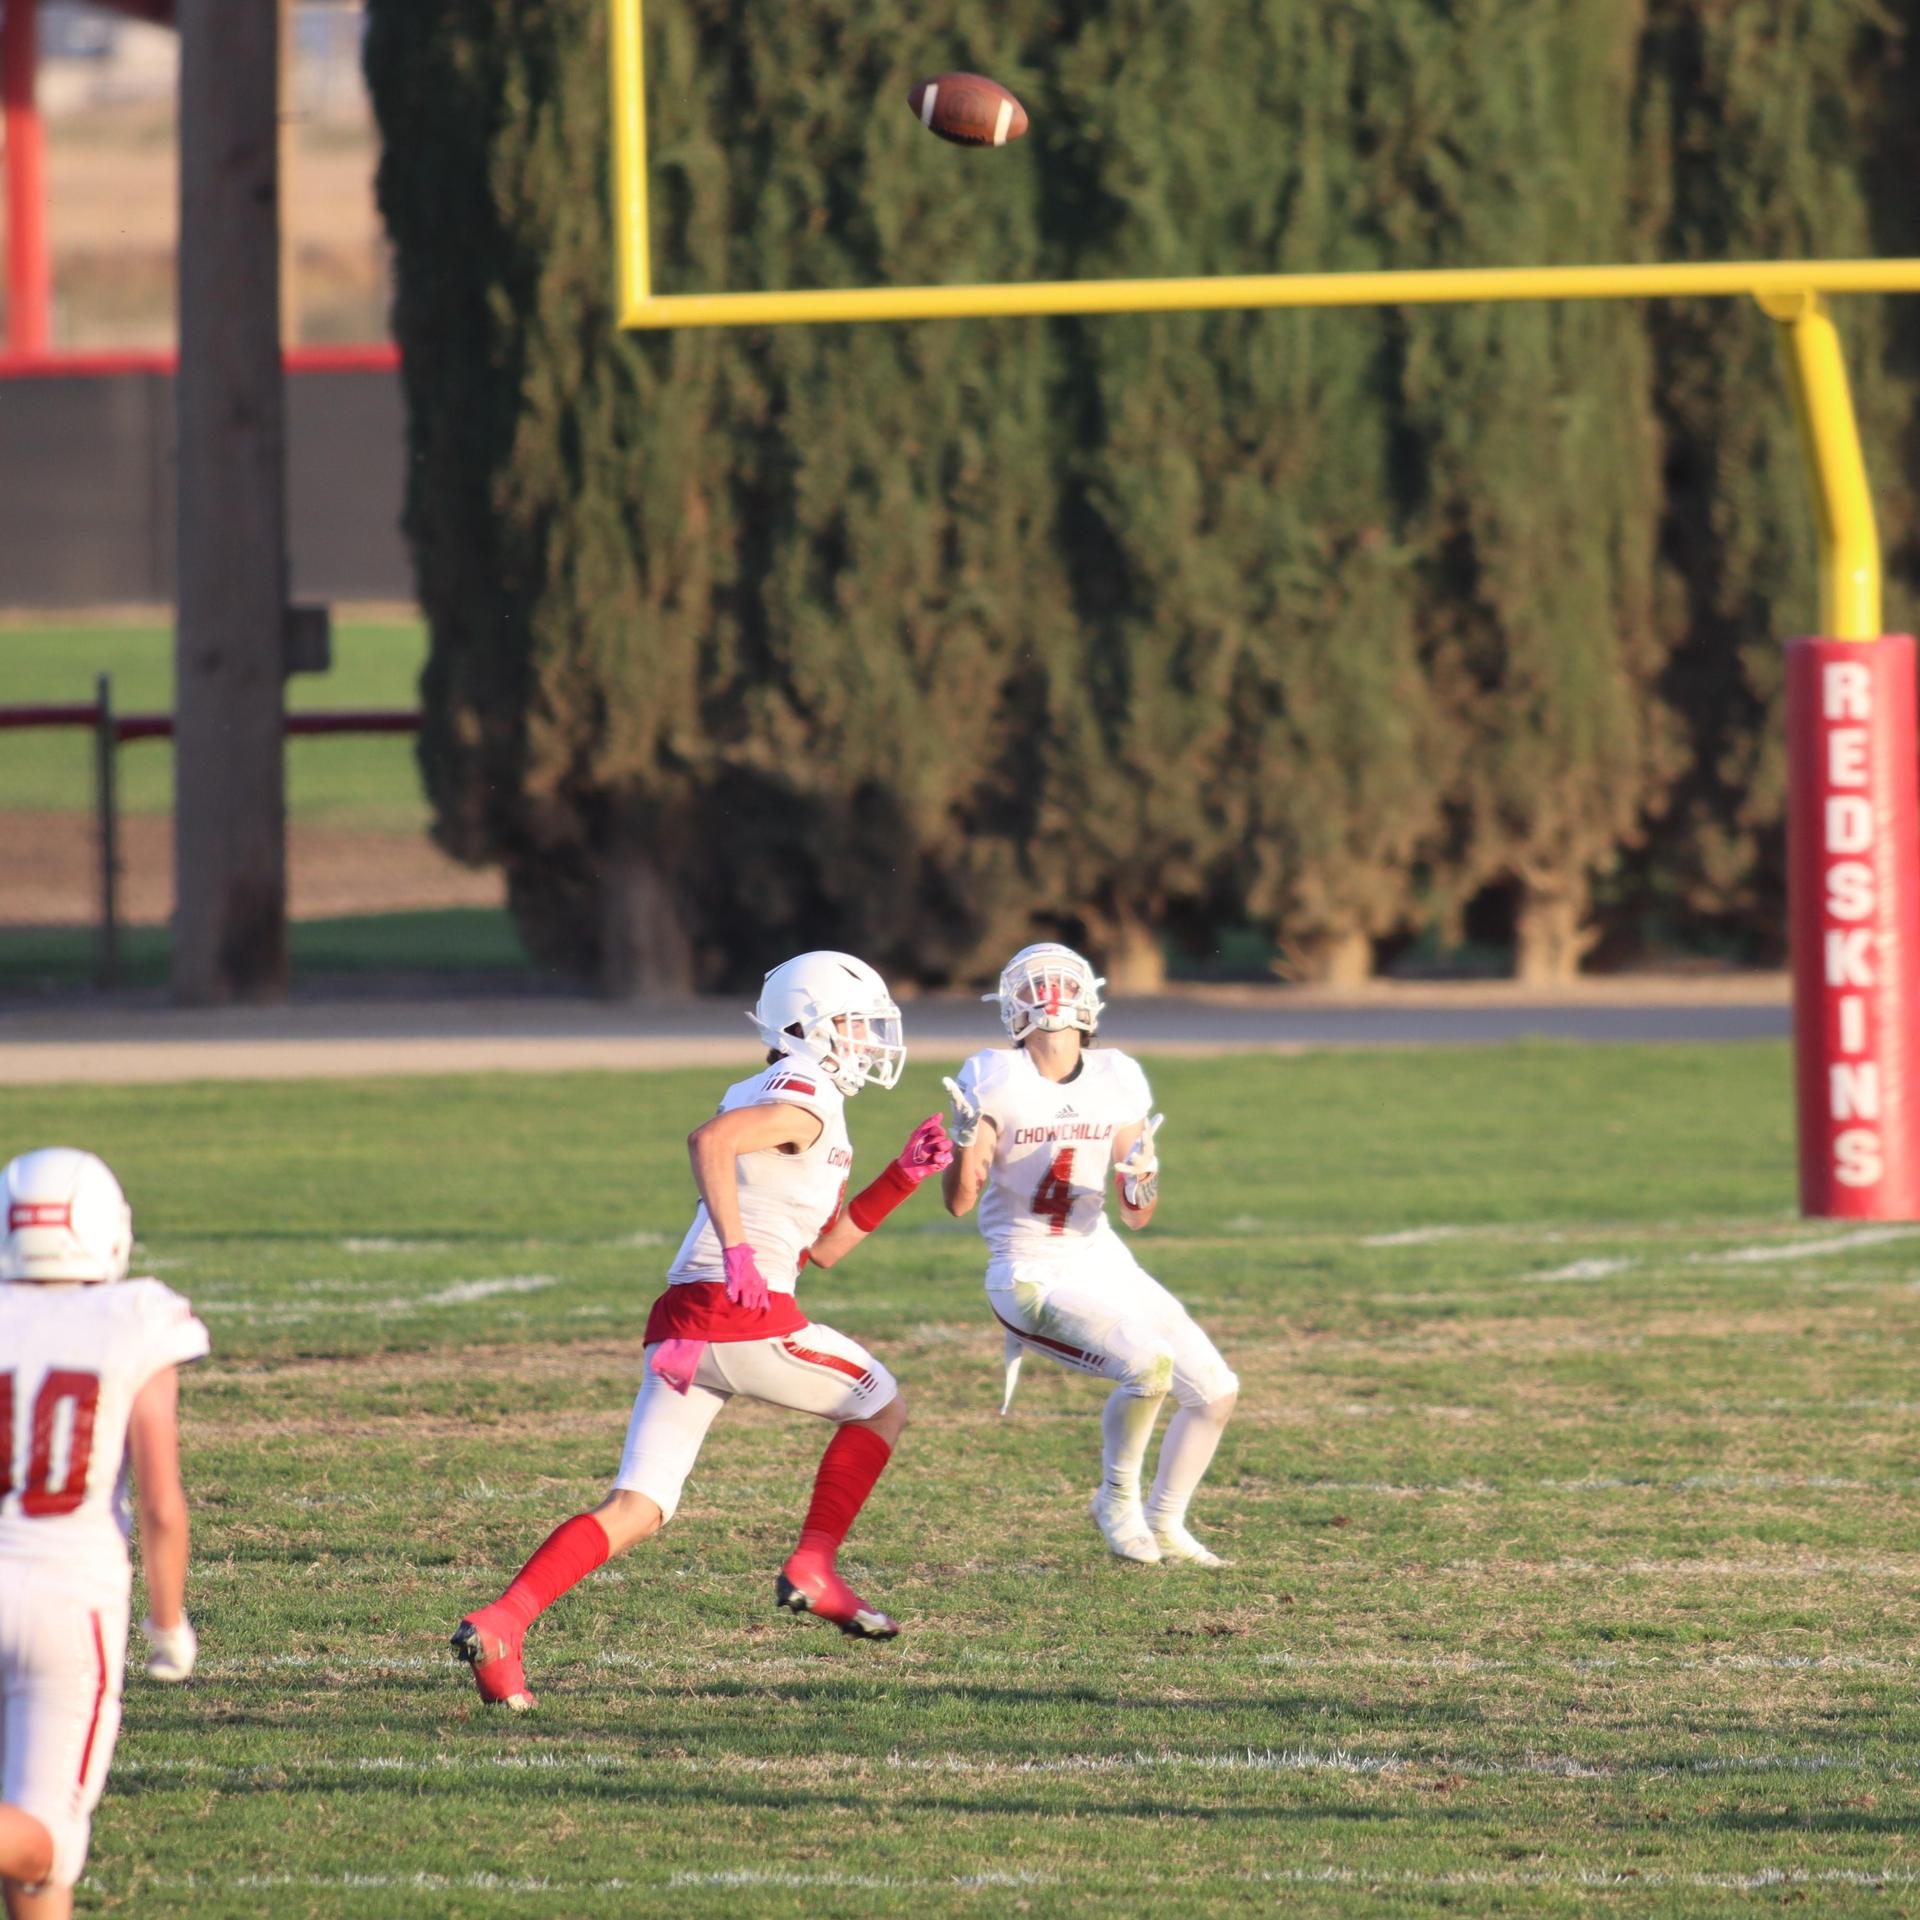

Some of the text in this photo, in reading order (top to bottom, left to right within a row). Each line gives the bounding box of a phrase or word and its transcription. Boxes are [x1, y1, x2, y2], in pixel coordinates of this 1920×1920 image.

[1822, 661, 1882, 1187] REDSKINS
[1014, 1123, 1112, 1144] CHOWCHILLA
[1031, 1147, 1078, 1236] 4
